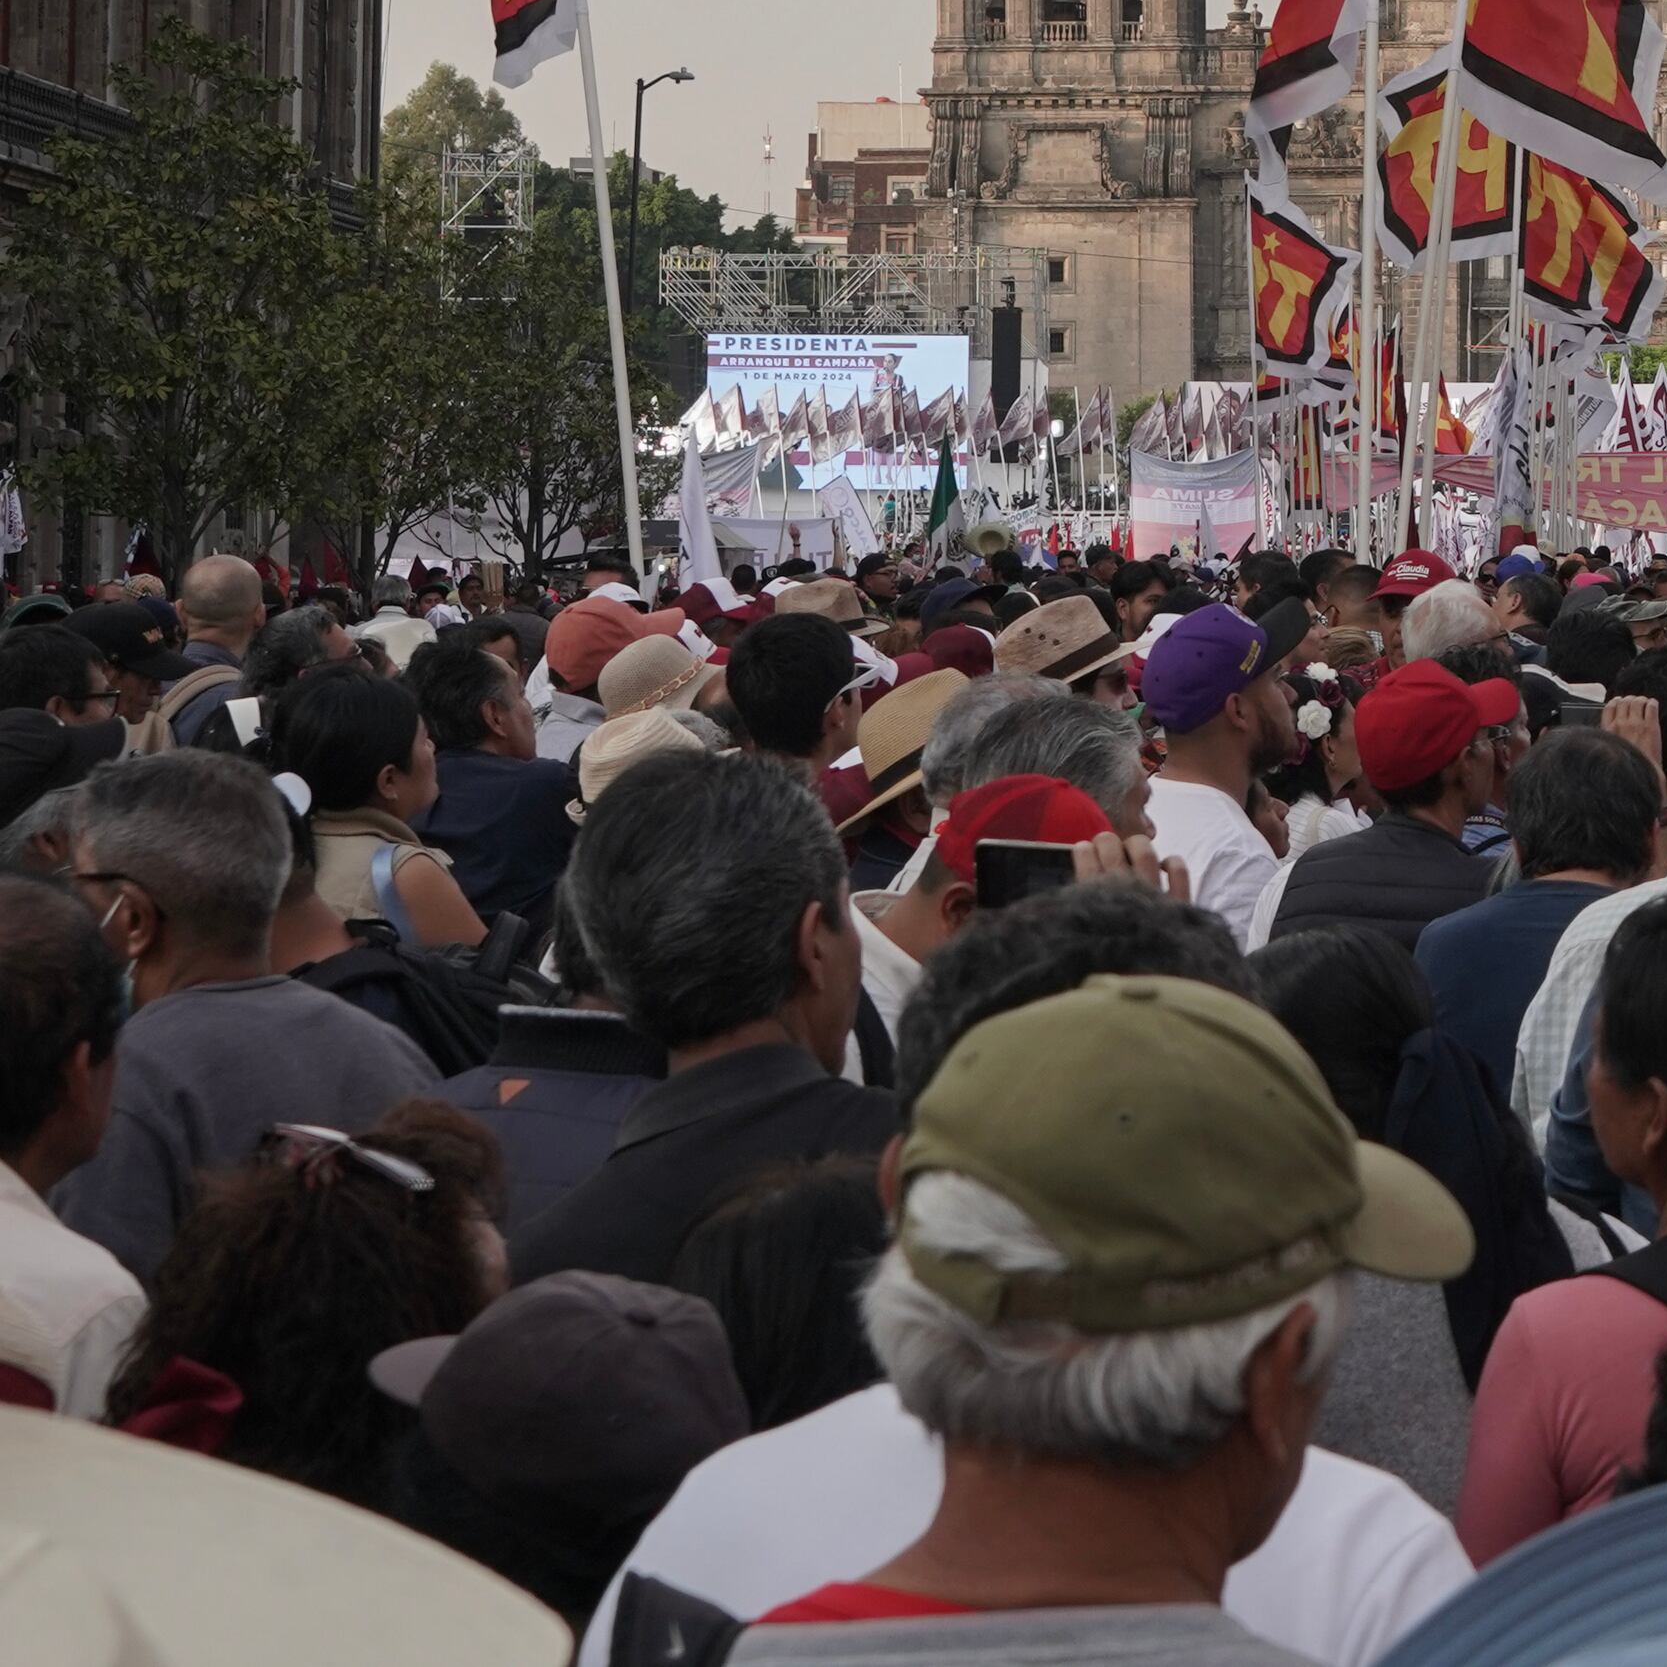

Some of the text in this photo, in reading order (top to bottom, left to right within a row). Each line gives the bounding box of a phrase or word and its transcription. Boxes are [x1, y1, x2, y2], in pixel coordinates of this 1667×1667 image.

[724, 336, 868, 352] PRESIDENTA
[719, 355, 875, 367] ARRANQUE DE CAMPAÑA
[743, 372, 852, 381] 1 DE MARZO 2024
[1396, 564, 1431, 575] Claudia
